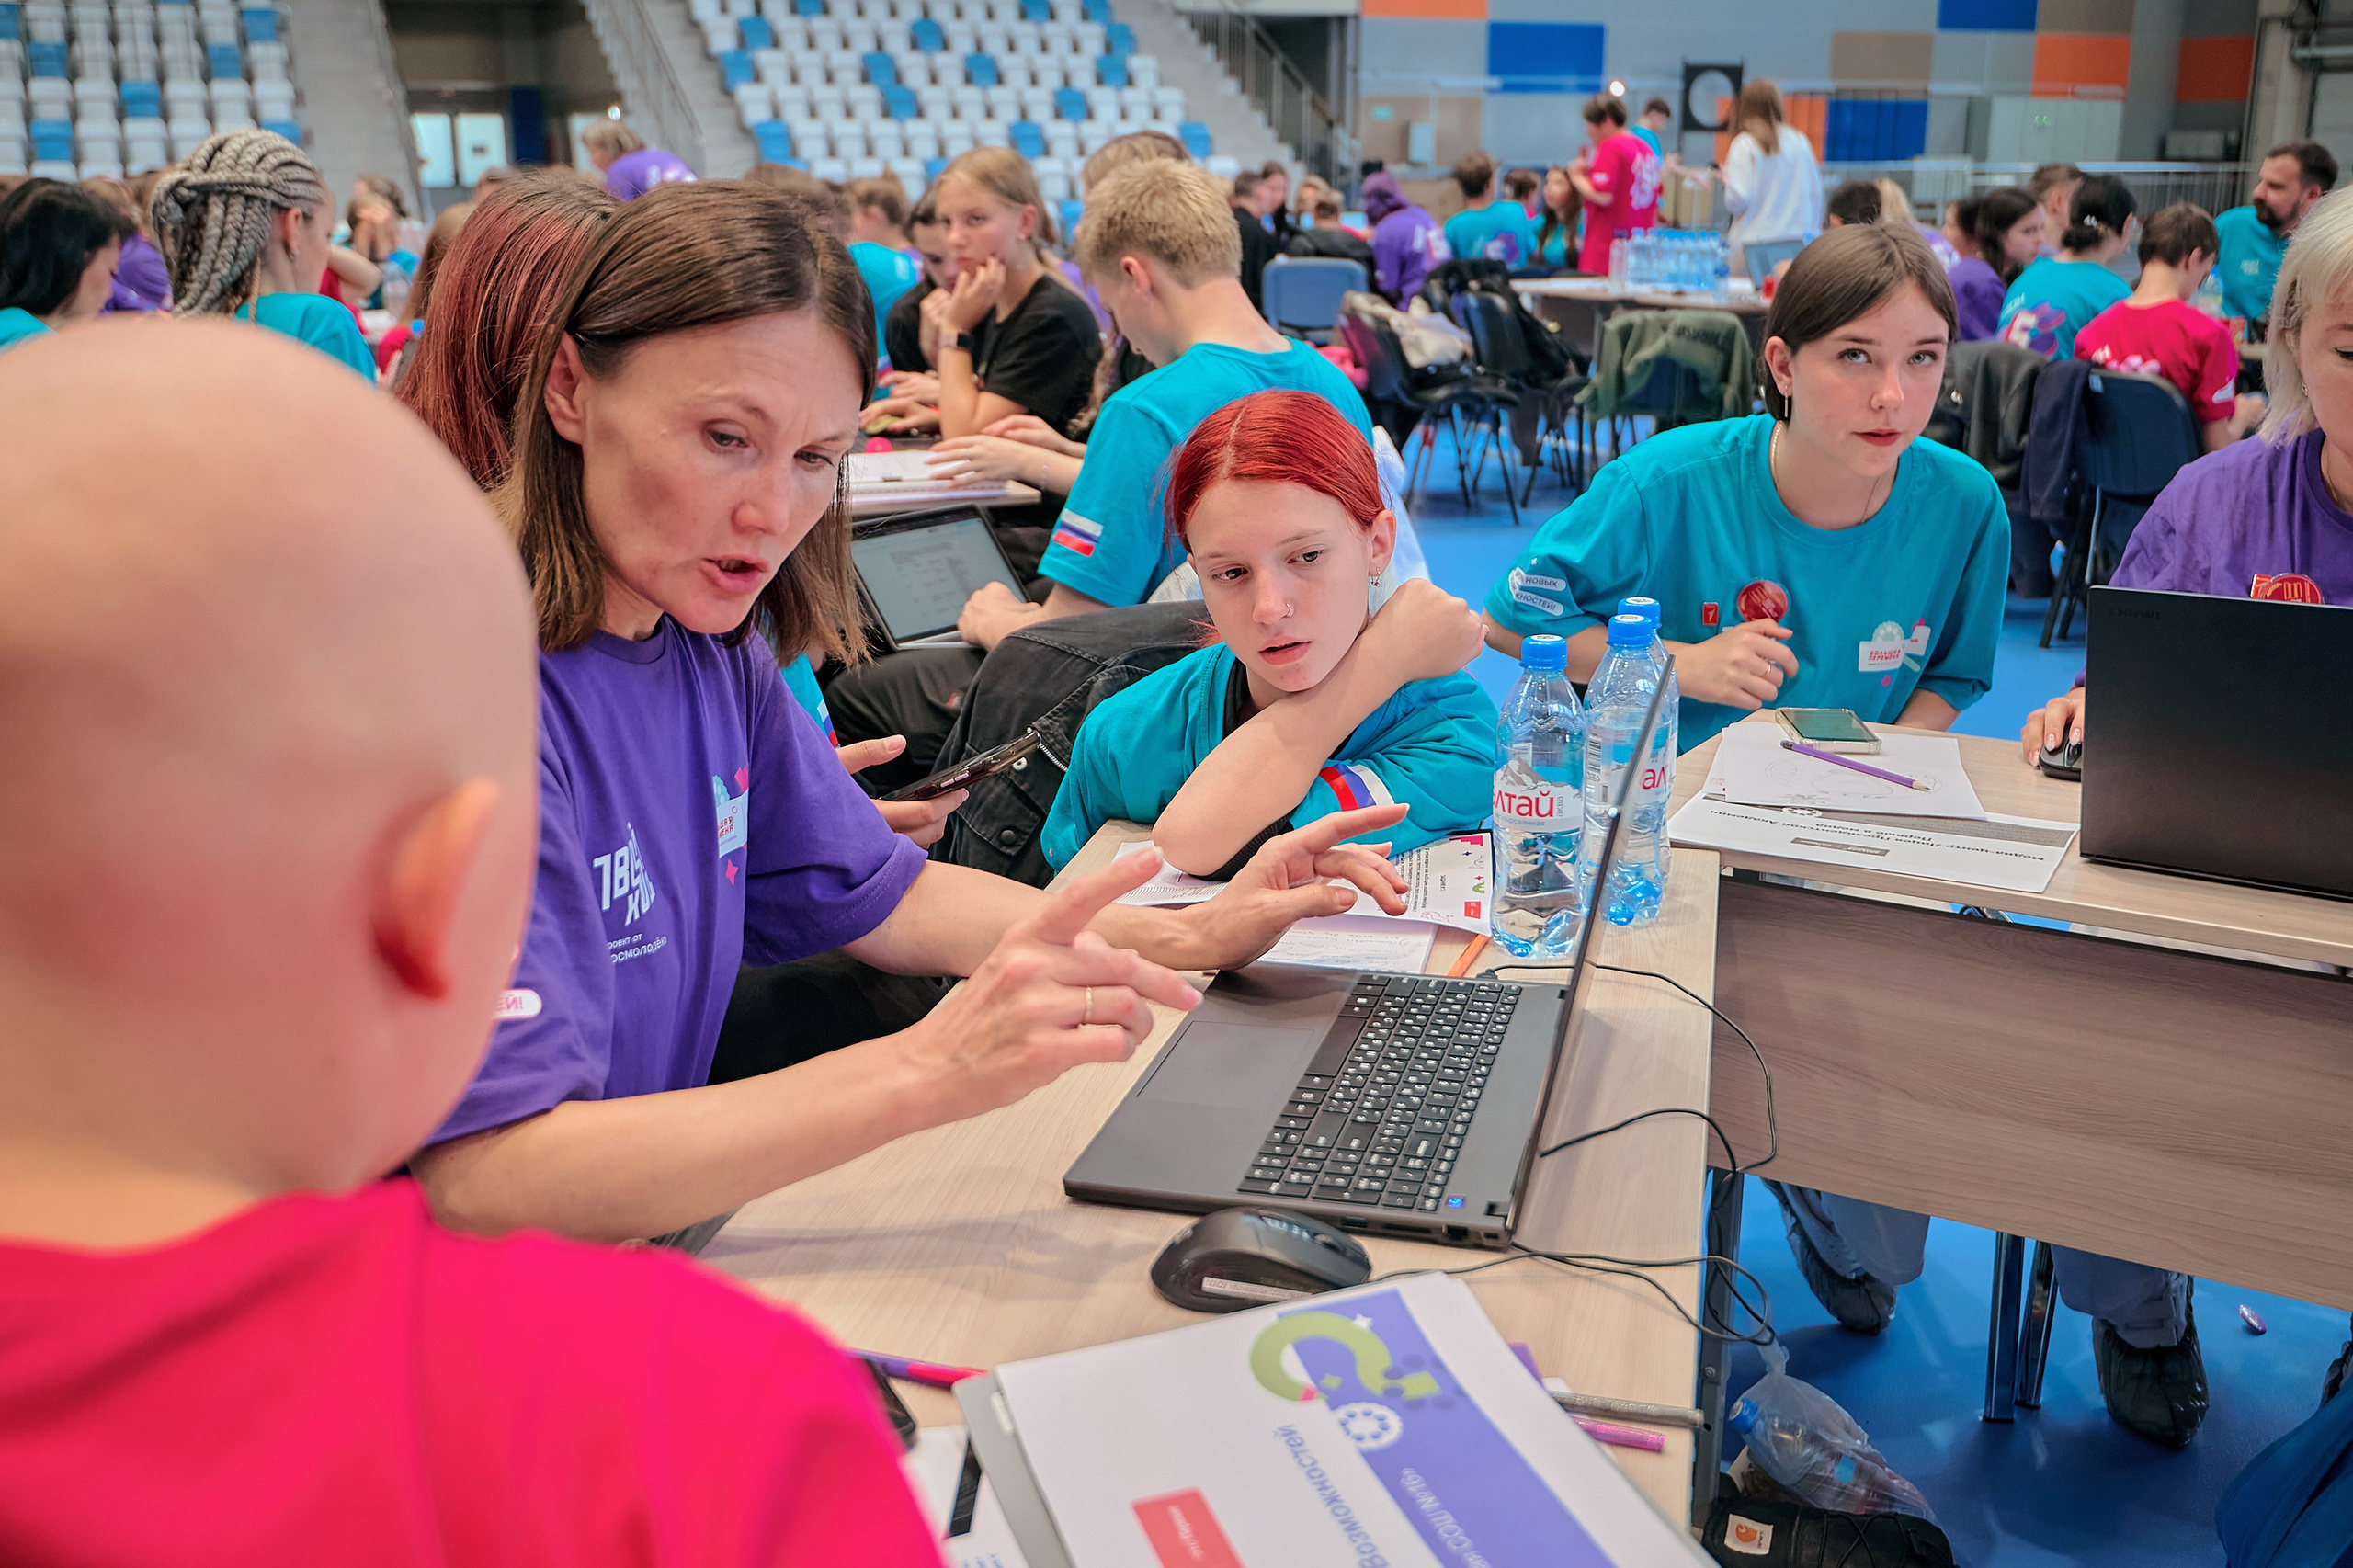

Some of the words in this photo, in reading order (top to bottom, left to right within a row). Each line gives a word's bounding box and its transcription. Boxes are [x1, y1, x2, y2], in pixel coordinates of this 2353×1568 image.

[1525, 576, 1558, 587] НОВЫХ
[1493, 790, 1554, 818] лтай
[1710, 809, 1779, 824] Академии
[1781, 822, 1891, 841] Президентской
[1815, 823, 1860, 833] медиа
[1875, 830, 1933, 842] Первые
[1895, 837, 1942, 847] Лицея
[1945, 844, 2045, 862] Медиа-центр
[607, 936, 631, 949] роект
[1273, 1424, 1390, 1568] Возможностей
